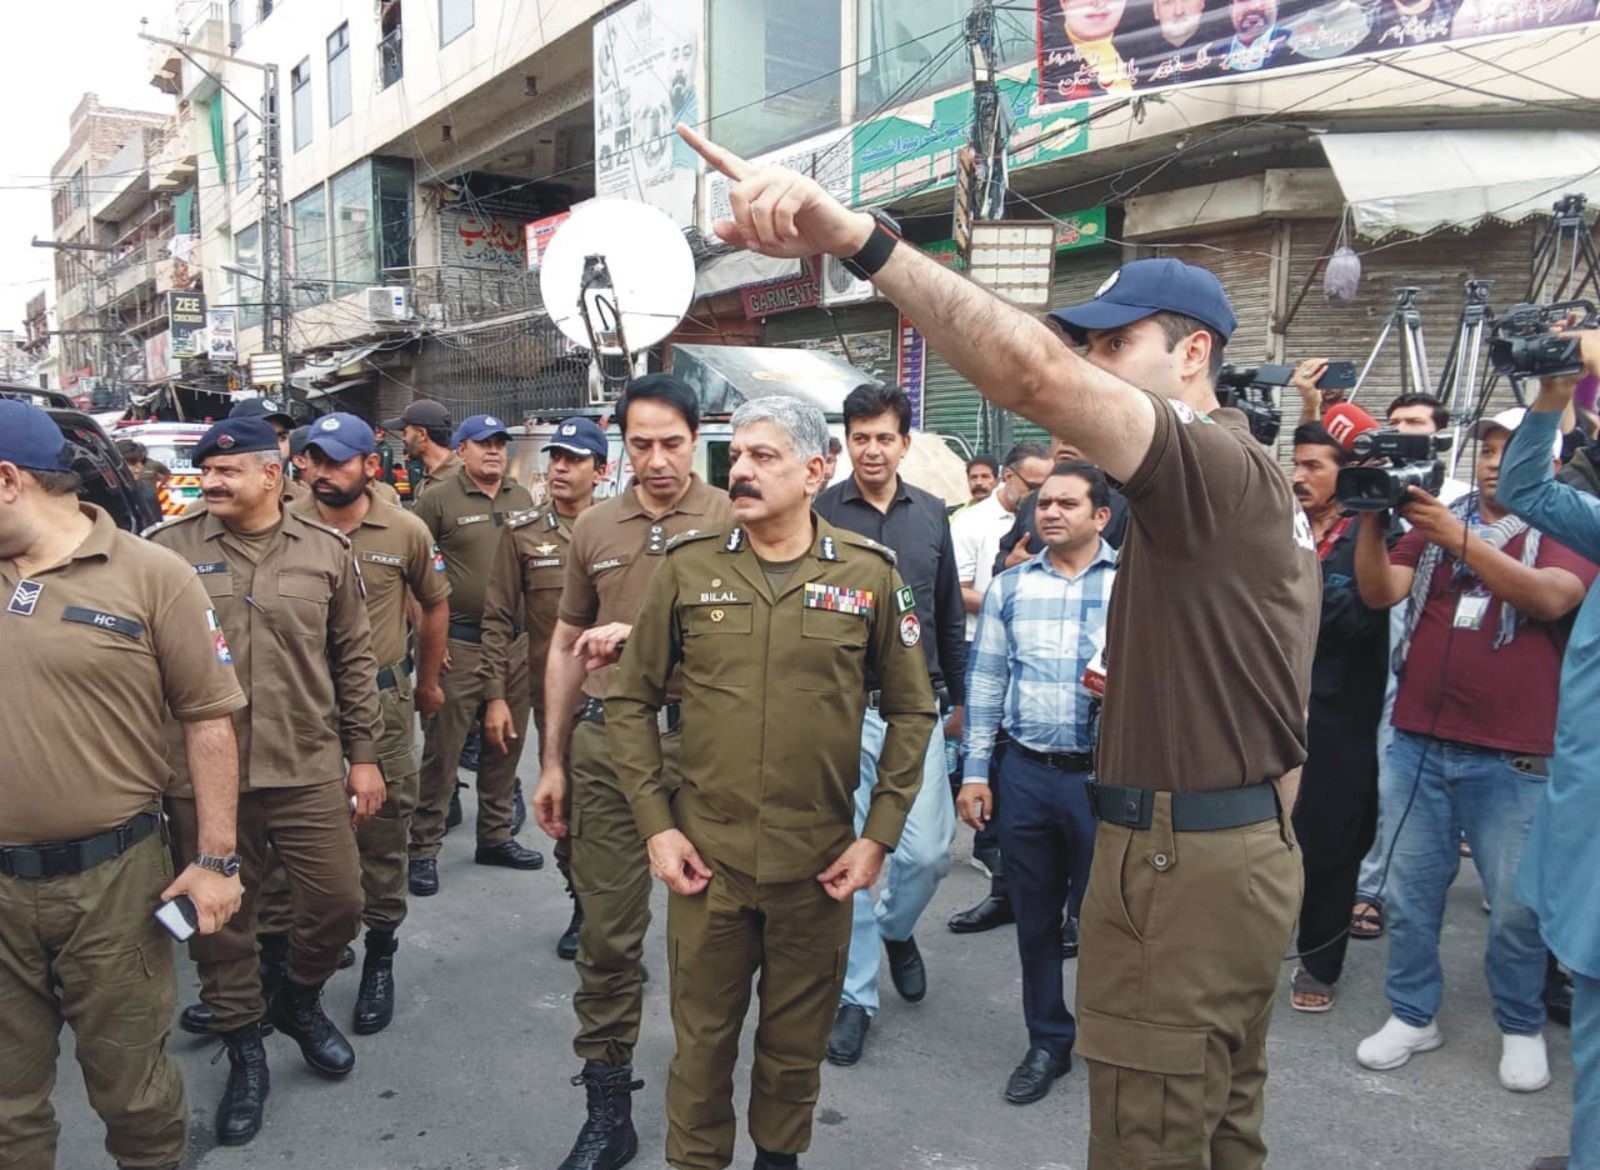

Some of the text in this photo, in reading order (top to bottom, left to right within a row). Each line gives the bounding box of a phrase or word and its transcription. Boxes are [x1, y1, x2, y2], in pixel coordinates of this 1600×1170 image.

[750, 282, 821, 312] GARMENTS
[175, 297, 201, 313] ZEE
[700, 591, 738, 602] BILAL
[93, 613, 117, 626] HC
